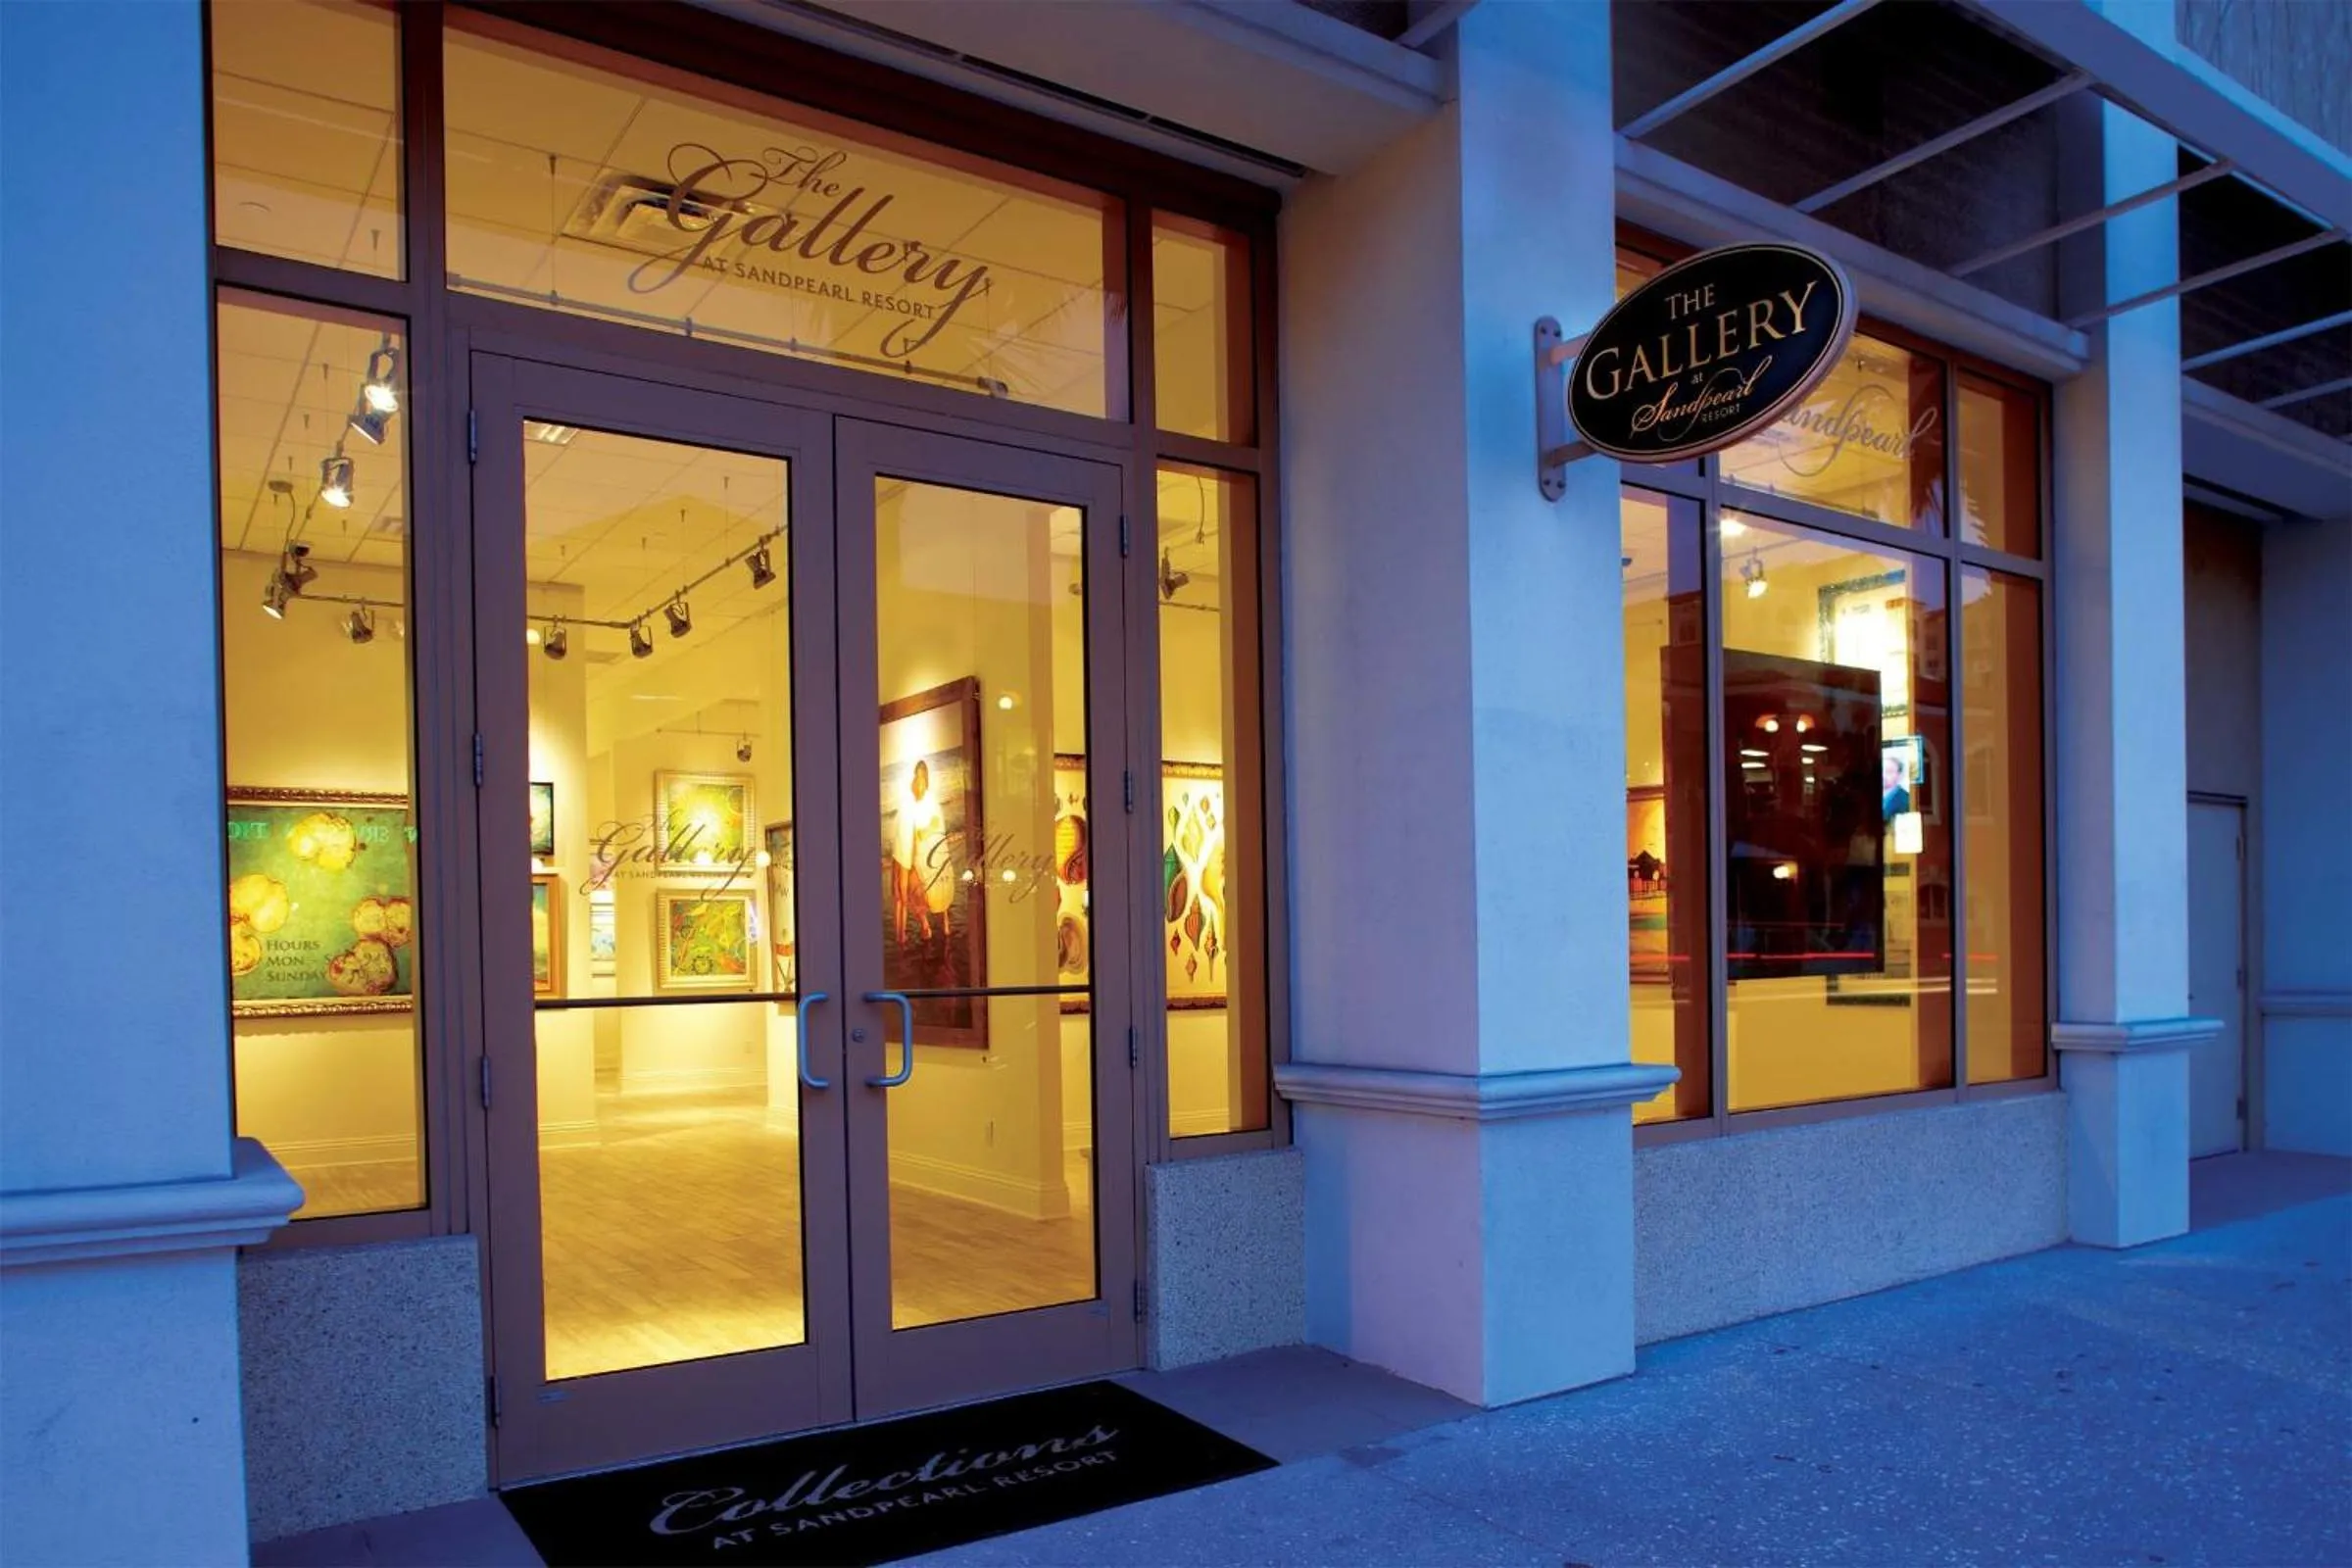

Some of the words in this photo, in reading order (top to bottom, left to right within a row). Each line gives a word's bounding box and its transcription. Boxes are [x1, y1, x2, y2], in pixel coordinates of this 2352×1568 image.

[750, 146, 848, 198] The
[628, 143, 992, 358] Gallery
[702, 256, 728, 273] AT
[734, 263, 855, 303] SANDPEARL
[861, 291, 936, 320] RESORT
[1664, 283, 1716, 321] THE
[1586, 280, 1819, 400] GALLERY
[1629, 355, 1773, 442] Sandpearl
[1690, 372, 1704, 385] at
[1701, 403, 1740, 422] RESORT
[1778, 384, 1938, 477] andpearl
[579, 821, 759, 903] Gallery
[266, 970, 325, 982] SUNDAY
[267, 940, 320, 952] HOURS
[267, 956, 304, 967] MON
[649, 1423, 1119, 1536] Collections
[713, 1528, 756, 1550] AT
[769, 1483, 986, 1537] SANDPEARL
[993, 1450, 1118, 1489] RESORT
